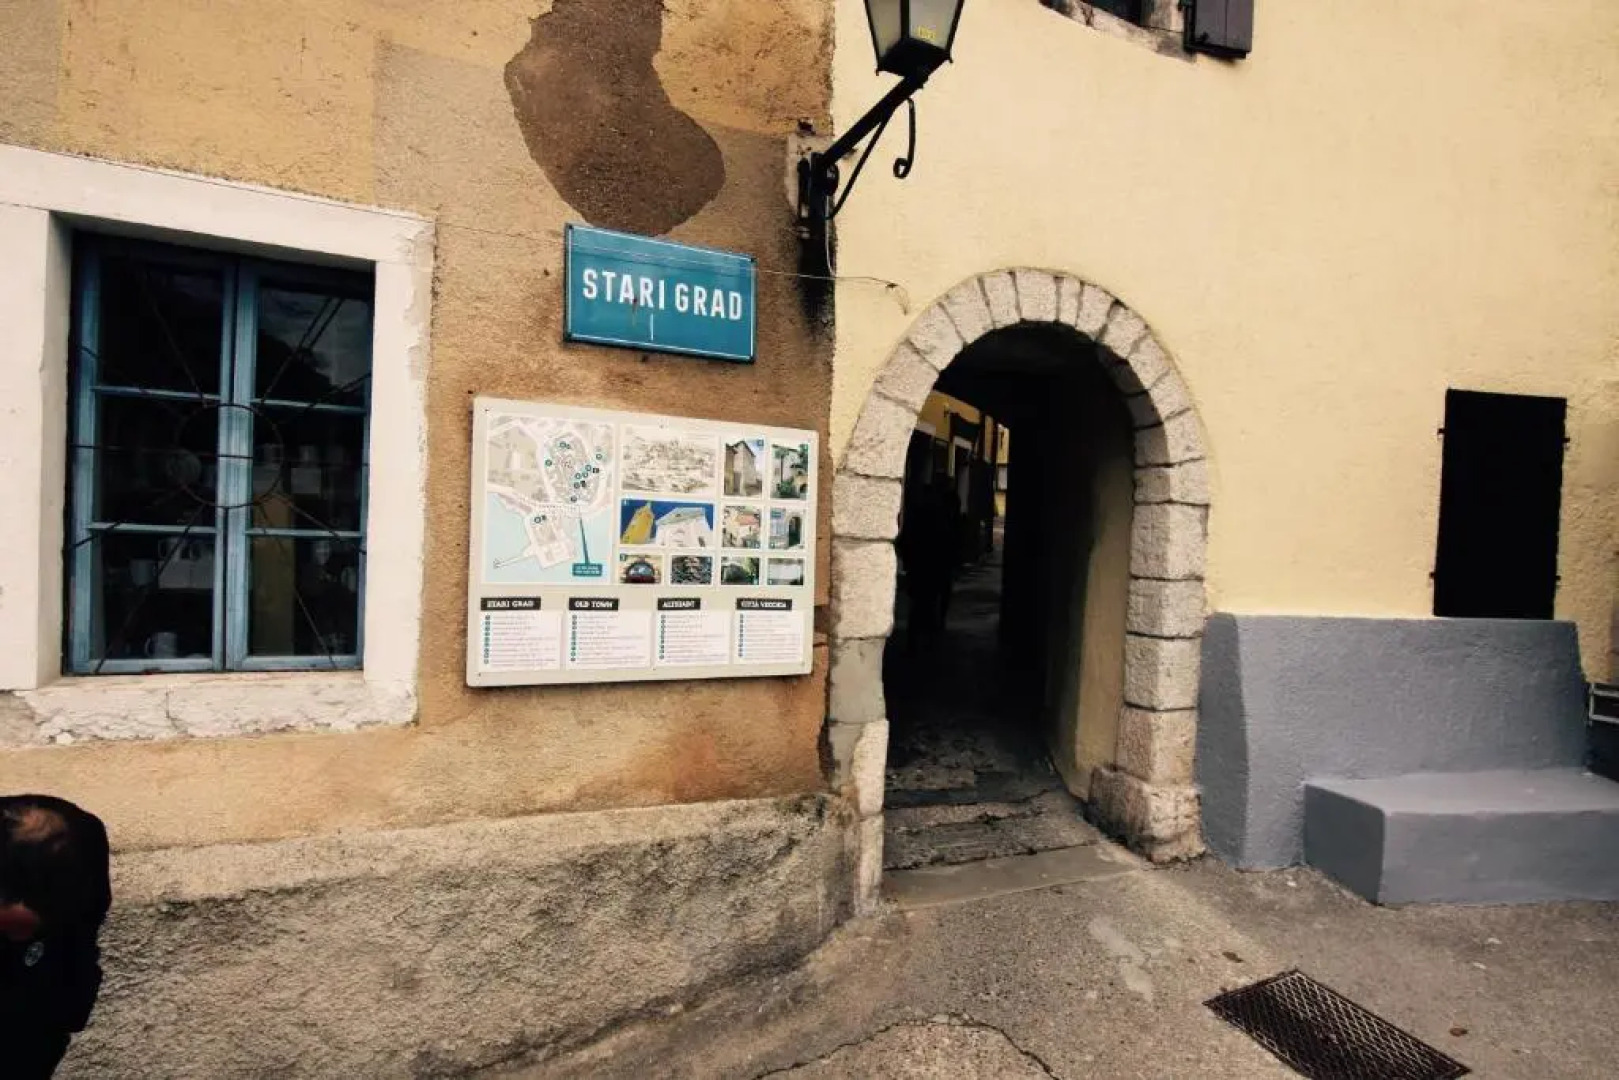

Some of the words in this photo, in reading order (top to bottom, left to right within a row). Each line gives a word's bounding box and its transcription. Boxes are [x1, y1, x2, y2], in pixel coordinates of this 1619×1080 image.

[582, 268, 665, 310] STARI
[674, 282, 742, 321] GRAD
[574, 600, 590, 608] OLD
[591, 600, 613, 608] TOWN
